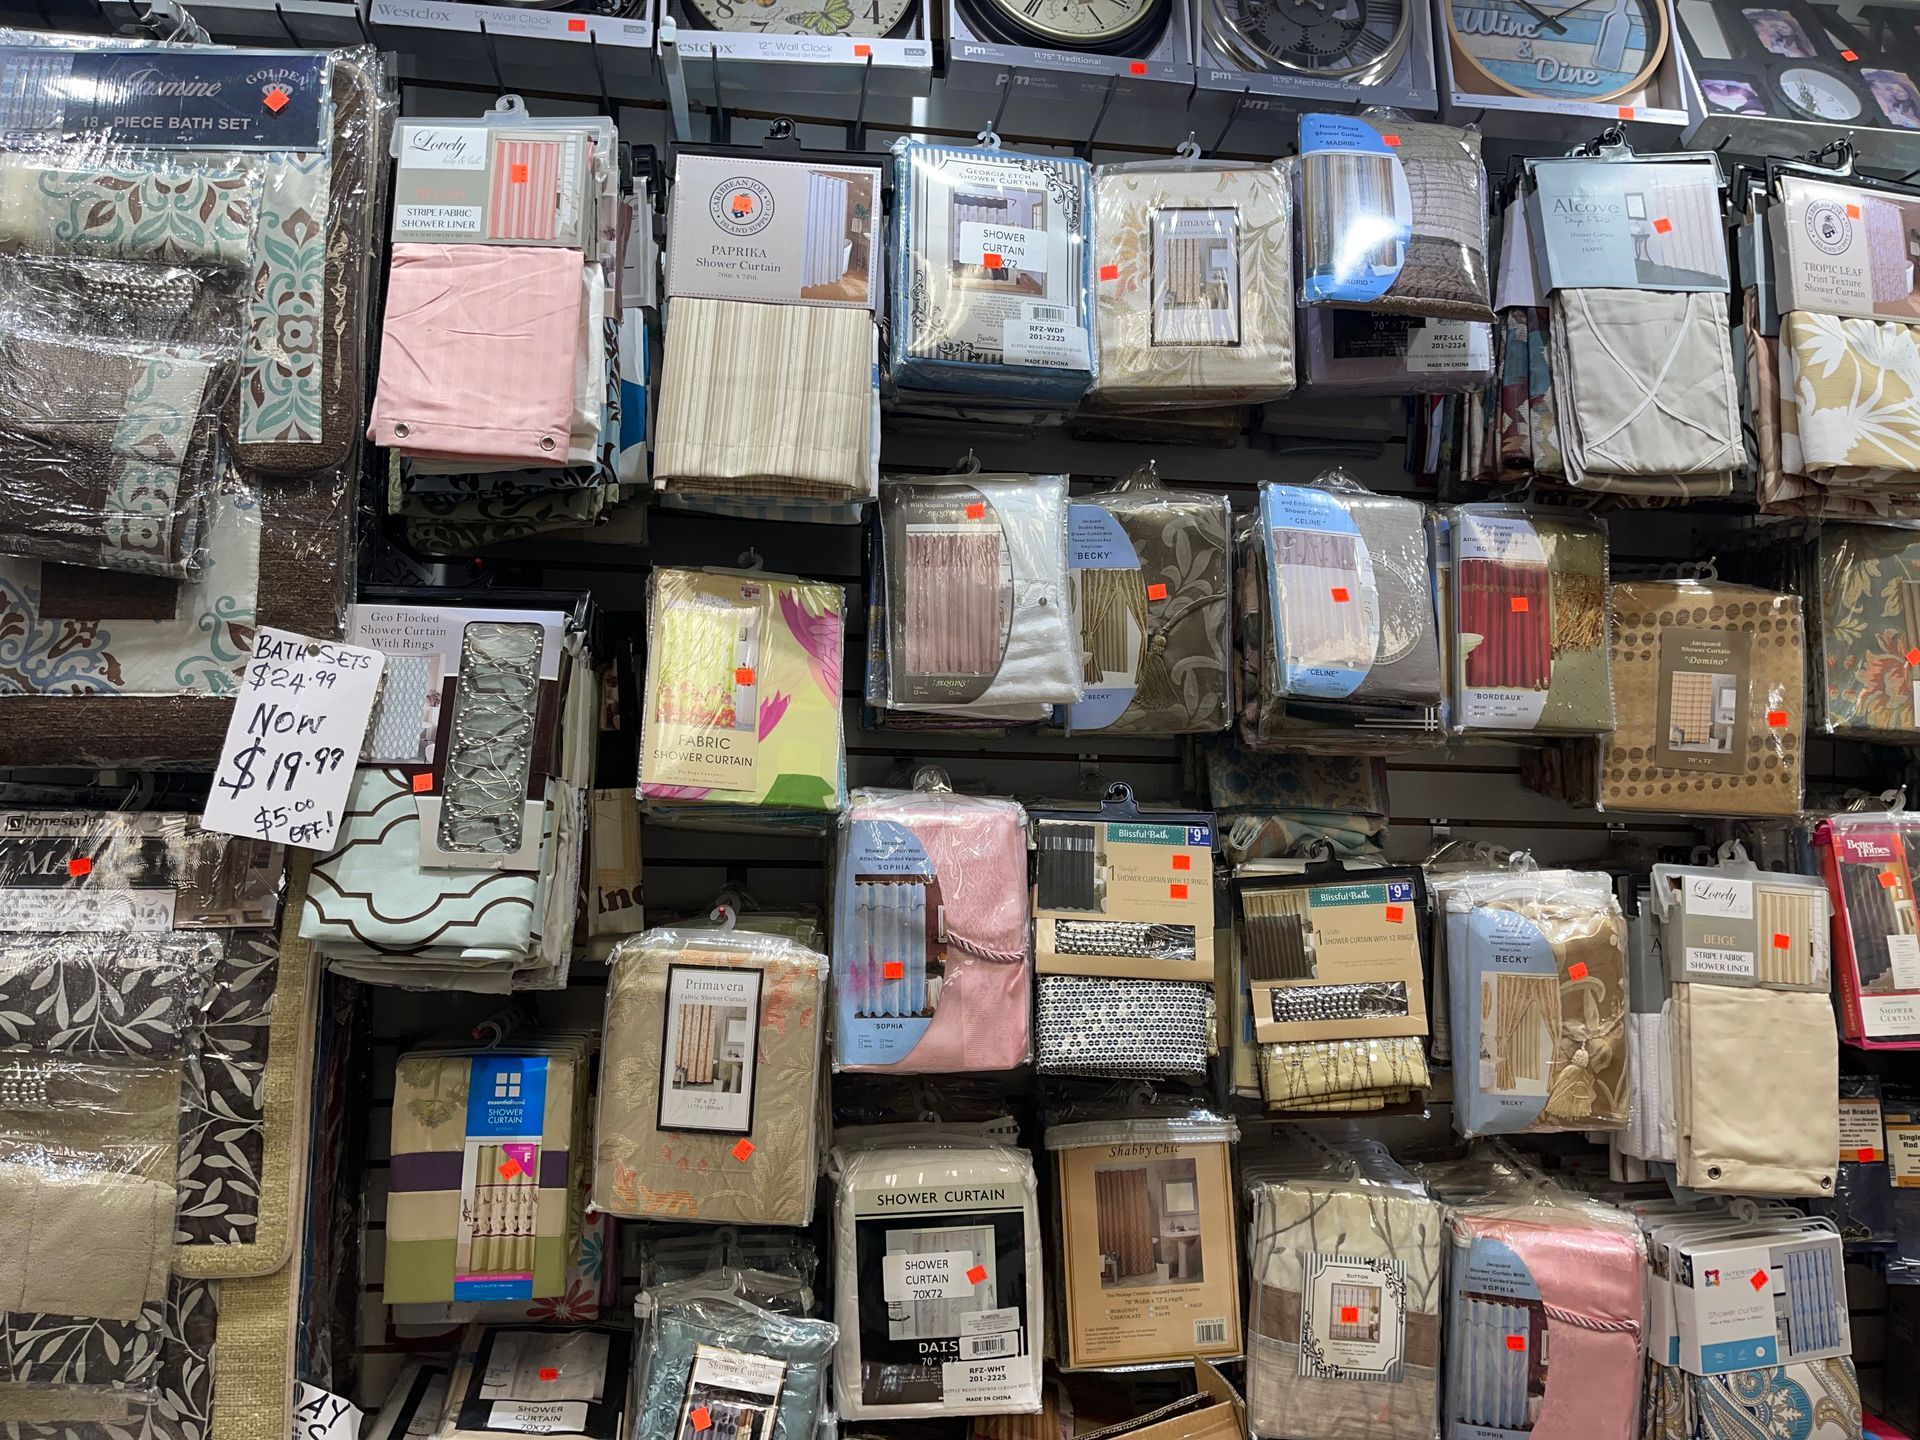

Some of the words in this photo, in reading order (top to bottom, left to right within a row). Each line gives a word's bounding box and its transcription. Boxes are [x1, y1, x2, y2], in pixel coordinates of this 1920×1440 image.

[377, 3, 450, 22] Westclox
[492, 11, 516, 22] Wall
[518, 14, 551, 26] Clock
[1462, 8, 1540, 39] Wine
[758, 41, 772, 50] 12"
[775, 42, 799, 51] Wall
[801, 43, 832, 53] Clock
[964, 45, 985, 56] pm
[1515, 40, 1533, 58] &
[1034, 51, 1055, 60] 11.75"
[1057, 53, 1101, 65] Traditional
[245, 68, 309, 86] GOLDEN
[1211, 71, 1231, 81] pm
[1532, 55, 1600, 85] Dine
[127, 68, 222, 97] Jasmine
[1272, 76, 1294, 84] 11.75"
[1294, 78, 1341, 89] Mechanical
[1343, 82, 1361, 91] Gear
[82, 117, 98, 128] 18
[114, 116, 163, 128] PIECE
[169, 117, 213, 129] BATH
[218, 118, 251, 130] SET
[408, 129, 468, 160] Lovely
[959, 173, 997, 184] SHOWER
[999, 177, 1039, 187] CURTAIN
[966, 168, 1005, 178] GEORGIA
[1008, 173, 1031, 181] ETCH
[713, 178, 750, 214] CARIBBEAN
[750, 179, 766, 196] JOE
[1553, 197, 1620, 214] Alcove
[407, 208, 437, 217] STRIPE
[439, 208, 472, 218] FABRIC
[401, 219, 445, 228] SHOWER
[447, 220, 475, 230] LINER
[719, 219, 748, 234] ISLAND
[749, 212, 772, 233] SUPPLY
[983, 229, 1026, 243] SHOWER
[711, 245, 767, 259] PAPRIKA
[983, 242, 1025, 256] CURTAIN
[695, 257, 737, 269] Shower
[739, 260, 781, 274] Curtain
[1802, 261, 1839, 274] TROPIC
[1840, 264, 1864, 277] LEAF
[1807, 272, 1830, 285] Print
[1830, 275, 1862, 288] Texture
[1804, 283, 1834, 296] Shower
[1835, 286, 1866, 298] Curtain
[1029, 325, 1065, 334] RFZ-WDF
[1029, 333, 1066, 342] 201-2223
[371, 612, 393, 623] Geo
[396, 612, 440, 624] Flocked
[360, 625, 402, 636] Shower
[404, 625, 447, 638] Curtain
[371, 637, 399, 649] With
[401, 638, 435, 652] Rings
[1681, 646, 1705, 654] Shower
[1706, 647, 1731, 655] Curtain
[1691, 640, 1721, 648] Jacquard
[253, 635, 309, 661] BATH
[318, 647, 372, 670] SETS
[247, 702, 327, 737] NOW
[679, 735, 731, 750] FABRIC
[654, 750, 702, 762] SHOWER
[705, 754, 752, 767] CURTAIN
[218, 736, 346, 800] $19.99
[24, 814, 96, 828] homestyle
[1118, 829, 1147, 839] Blissful
[1147, 830, 1169, 839] Bath
[1846, 839, 1875, 850] Better
[1857, 843, 1890, 857] Homes
[1108, 865, 1115, 881] 1
[1143, 875, 1167, 883] CURTAIN
[1167, 876, 1181, 884] WITH
[1183, 877, 1191, 885] 12
[1191, 878, 1209, 886] RINGS
[1320, 892, 1349, 902] Blissful
[1349, 889, 1371, 900] Bath
[1691, 879, 1737, 908] Lovely
[1315, 929, 1322, 946] 1
[1325, 937, 1349, 945] SHOWER
[1350, 936, 1373, 944] CURTAIN
[1703, 934, 1737, 946] BEIGE
[1694, 951, 1719, 960] STRIPE
[1720, 952, 1747, 962] FABRIC
[1690, 961, 1725, 971] SHOWER
[1727, 964, 1750, 973] LINER
[685, 978, 744, 992] Primavera
[680, 993, 700, 1001] Fabric
[701, 994, 723, 1002] Shower
[724, 995, 747, 1003] Curtain
[1880, 1007, 1914, 1015] SHOWER
[488, 1108, 524, 1116] SHOWER
[487, 1116, 522, 1124] CURTAIN
[1108, 1144, 1152, 1158] Shabby
[1154, 1143, 1180, 1155] Chic
[877, 1191, 938, 1206] SHOWER
[944, 1189, 1005, 1203] CURTAIN
[905, 1259, 949, 1271] SHOWER
[905, 1274, 949, 1285] CURTAIN
[912, 1289, 943, 1300] 70X72
[1707, 1310, 1736, 1320] Shower
[708, 1360, 738, 1373] Shower
[969, 1365, 1006, 1374] RFZ-WHT
[969, 1374, 1007, 1382] 201-2225
[518, 1405, 564, 1414] SHOWER
[515, 1414, 561, 1423] CURTAIN
